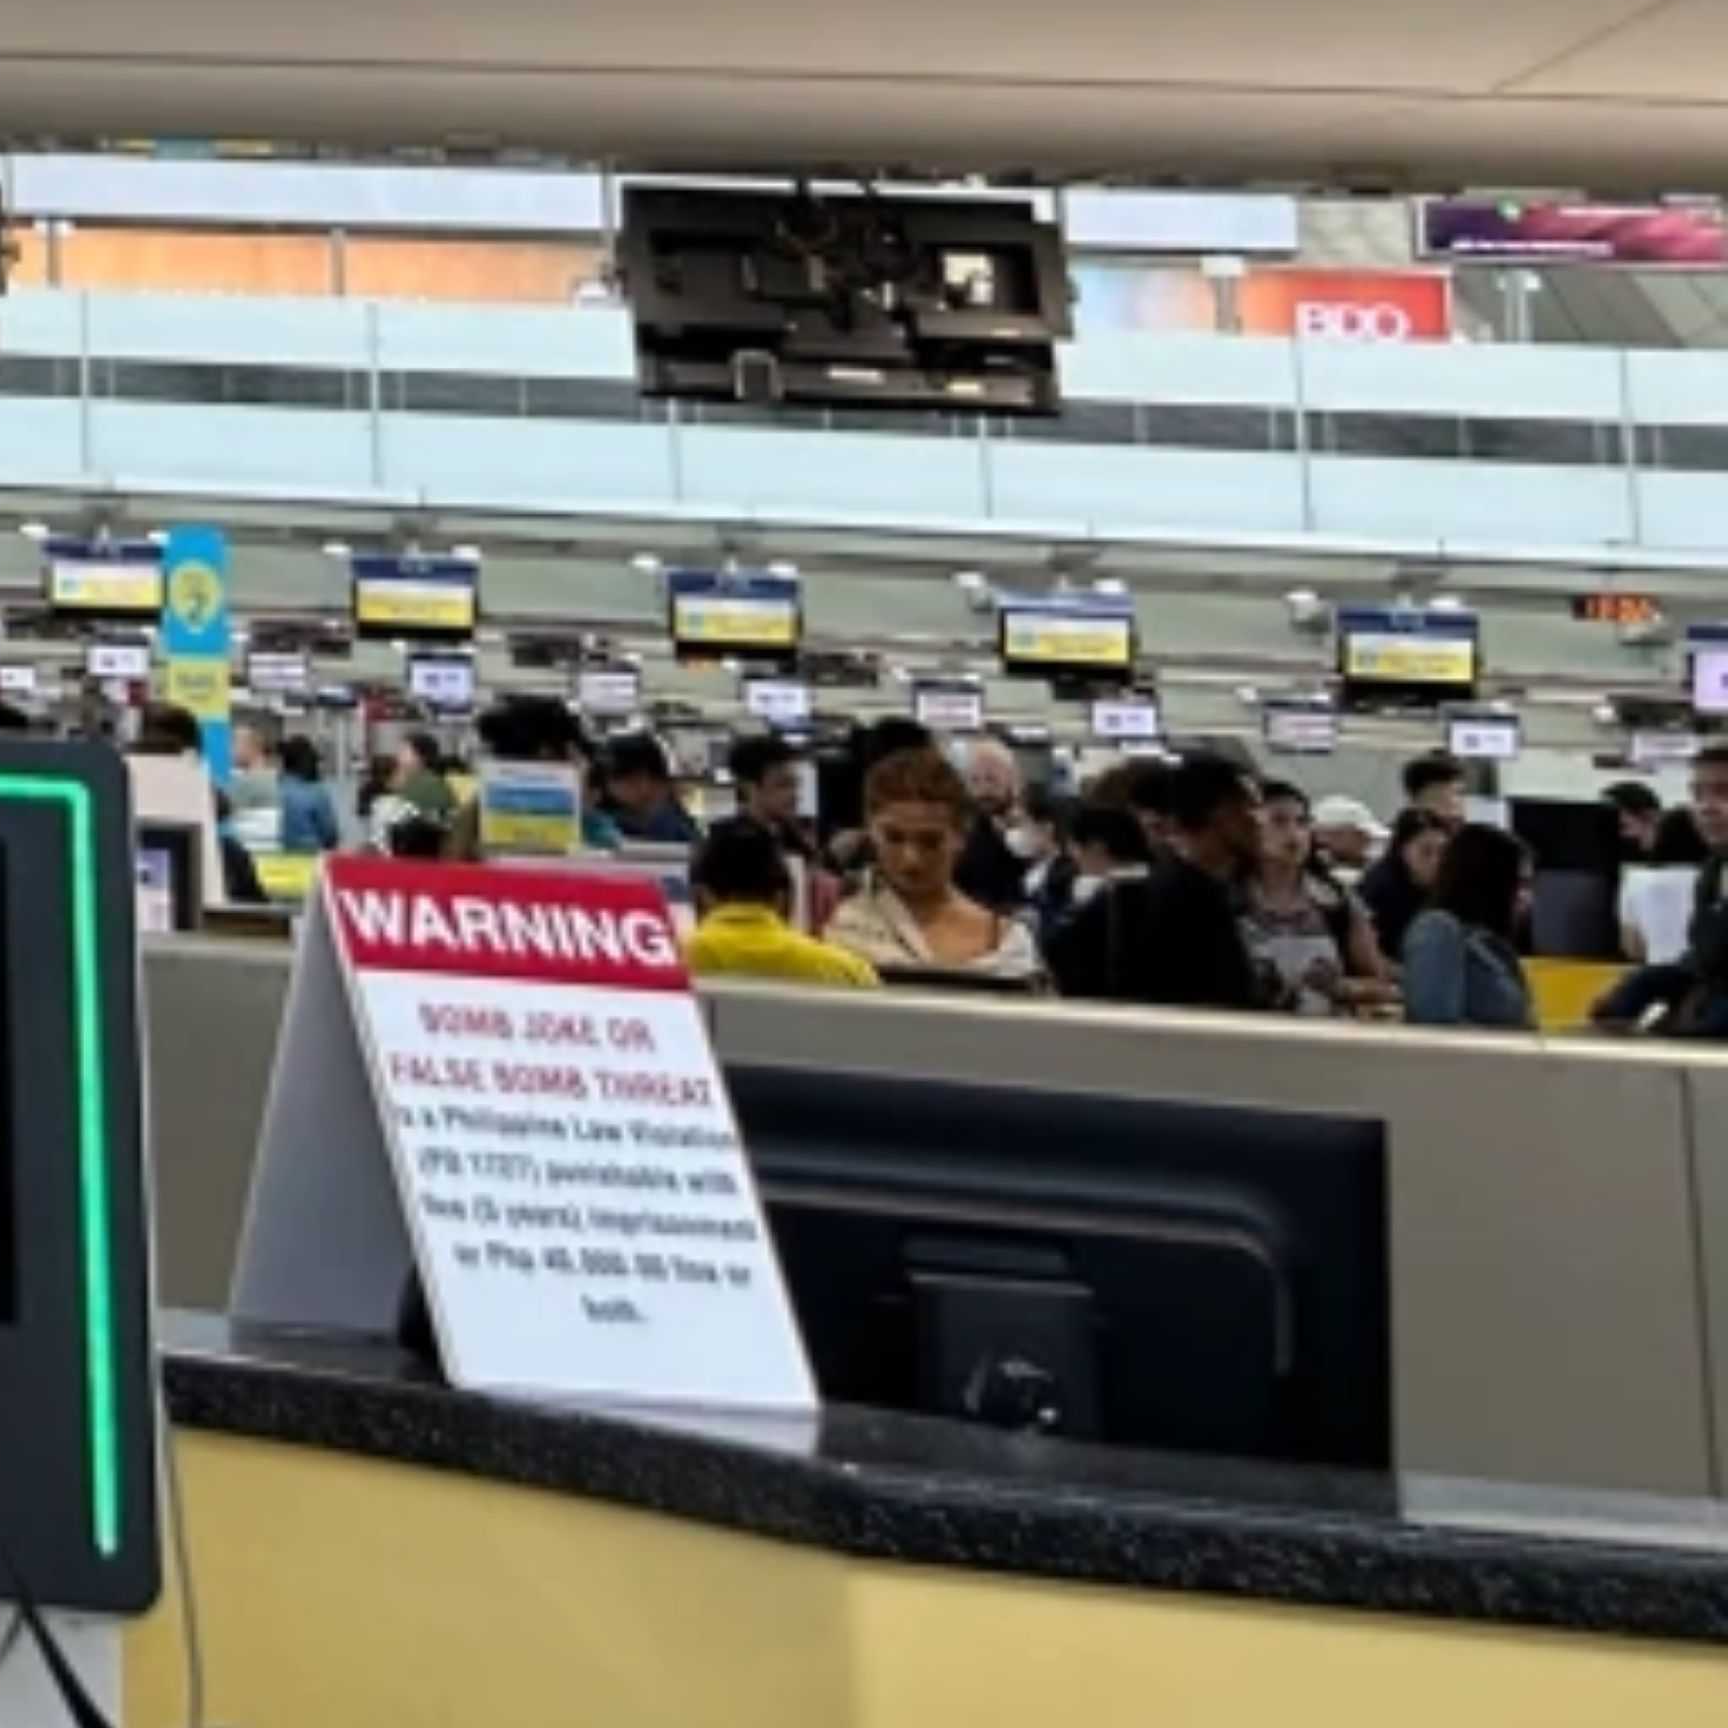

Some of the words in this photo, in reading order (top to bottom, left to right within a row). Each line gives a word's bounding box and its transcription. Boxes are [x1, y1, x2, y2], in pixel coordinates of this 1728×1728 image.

[338, 886, 678, 968] WARNING
[418, 1001, 516, 1041] BOMB
[522, 1011, 601, 1049] JOKE
[606, 1017, 656, 1053] OR
[389, 1051, 488, 1094] FALSE
[491, 1059, 590, 1102] BOMB
[593, 1071, 713, 1109] THREAT
